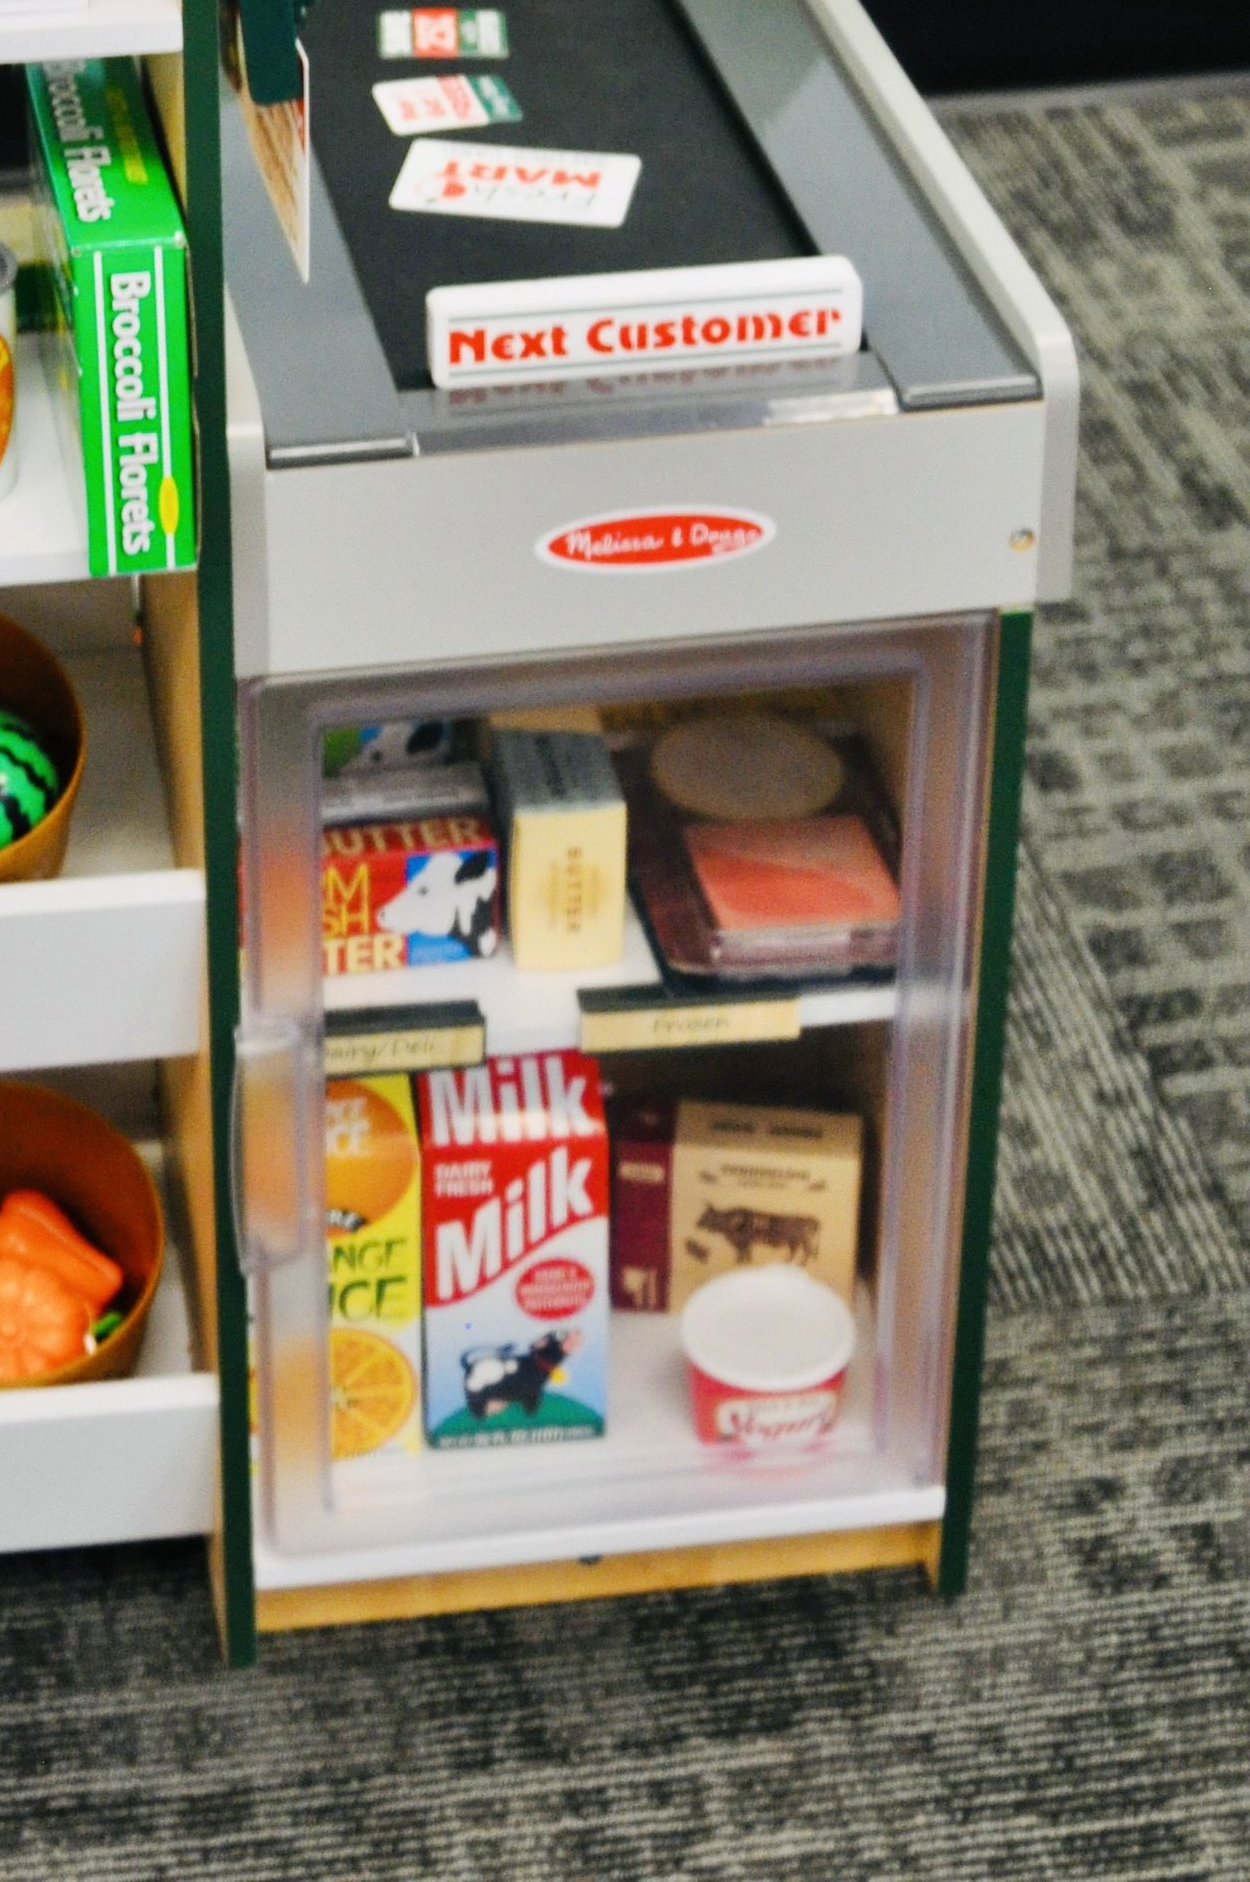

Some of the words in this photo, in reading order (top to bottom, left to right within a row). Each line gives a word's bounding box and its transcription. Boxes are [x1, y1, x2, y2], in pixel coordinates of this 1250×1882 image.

[110, 270, 157, 423] Broccoli
[449, 323, 569, 366] Next
[586, 307, 843, 353] Customer
[118, 428, 159, 557] Florets
[429, 1054, 595, 1147] Milk
[435, 1145, 593, 1301] Milk
